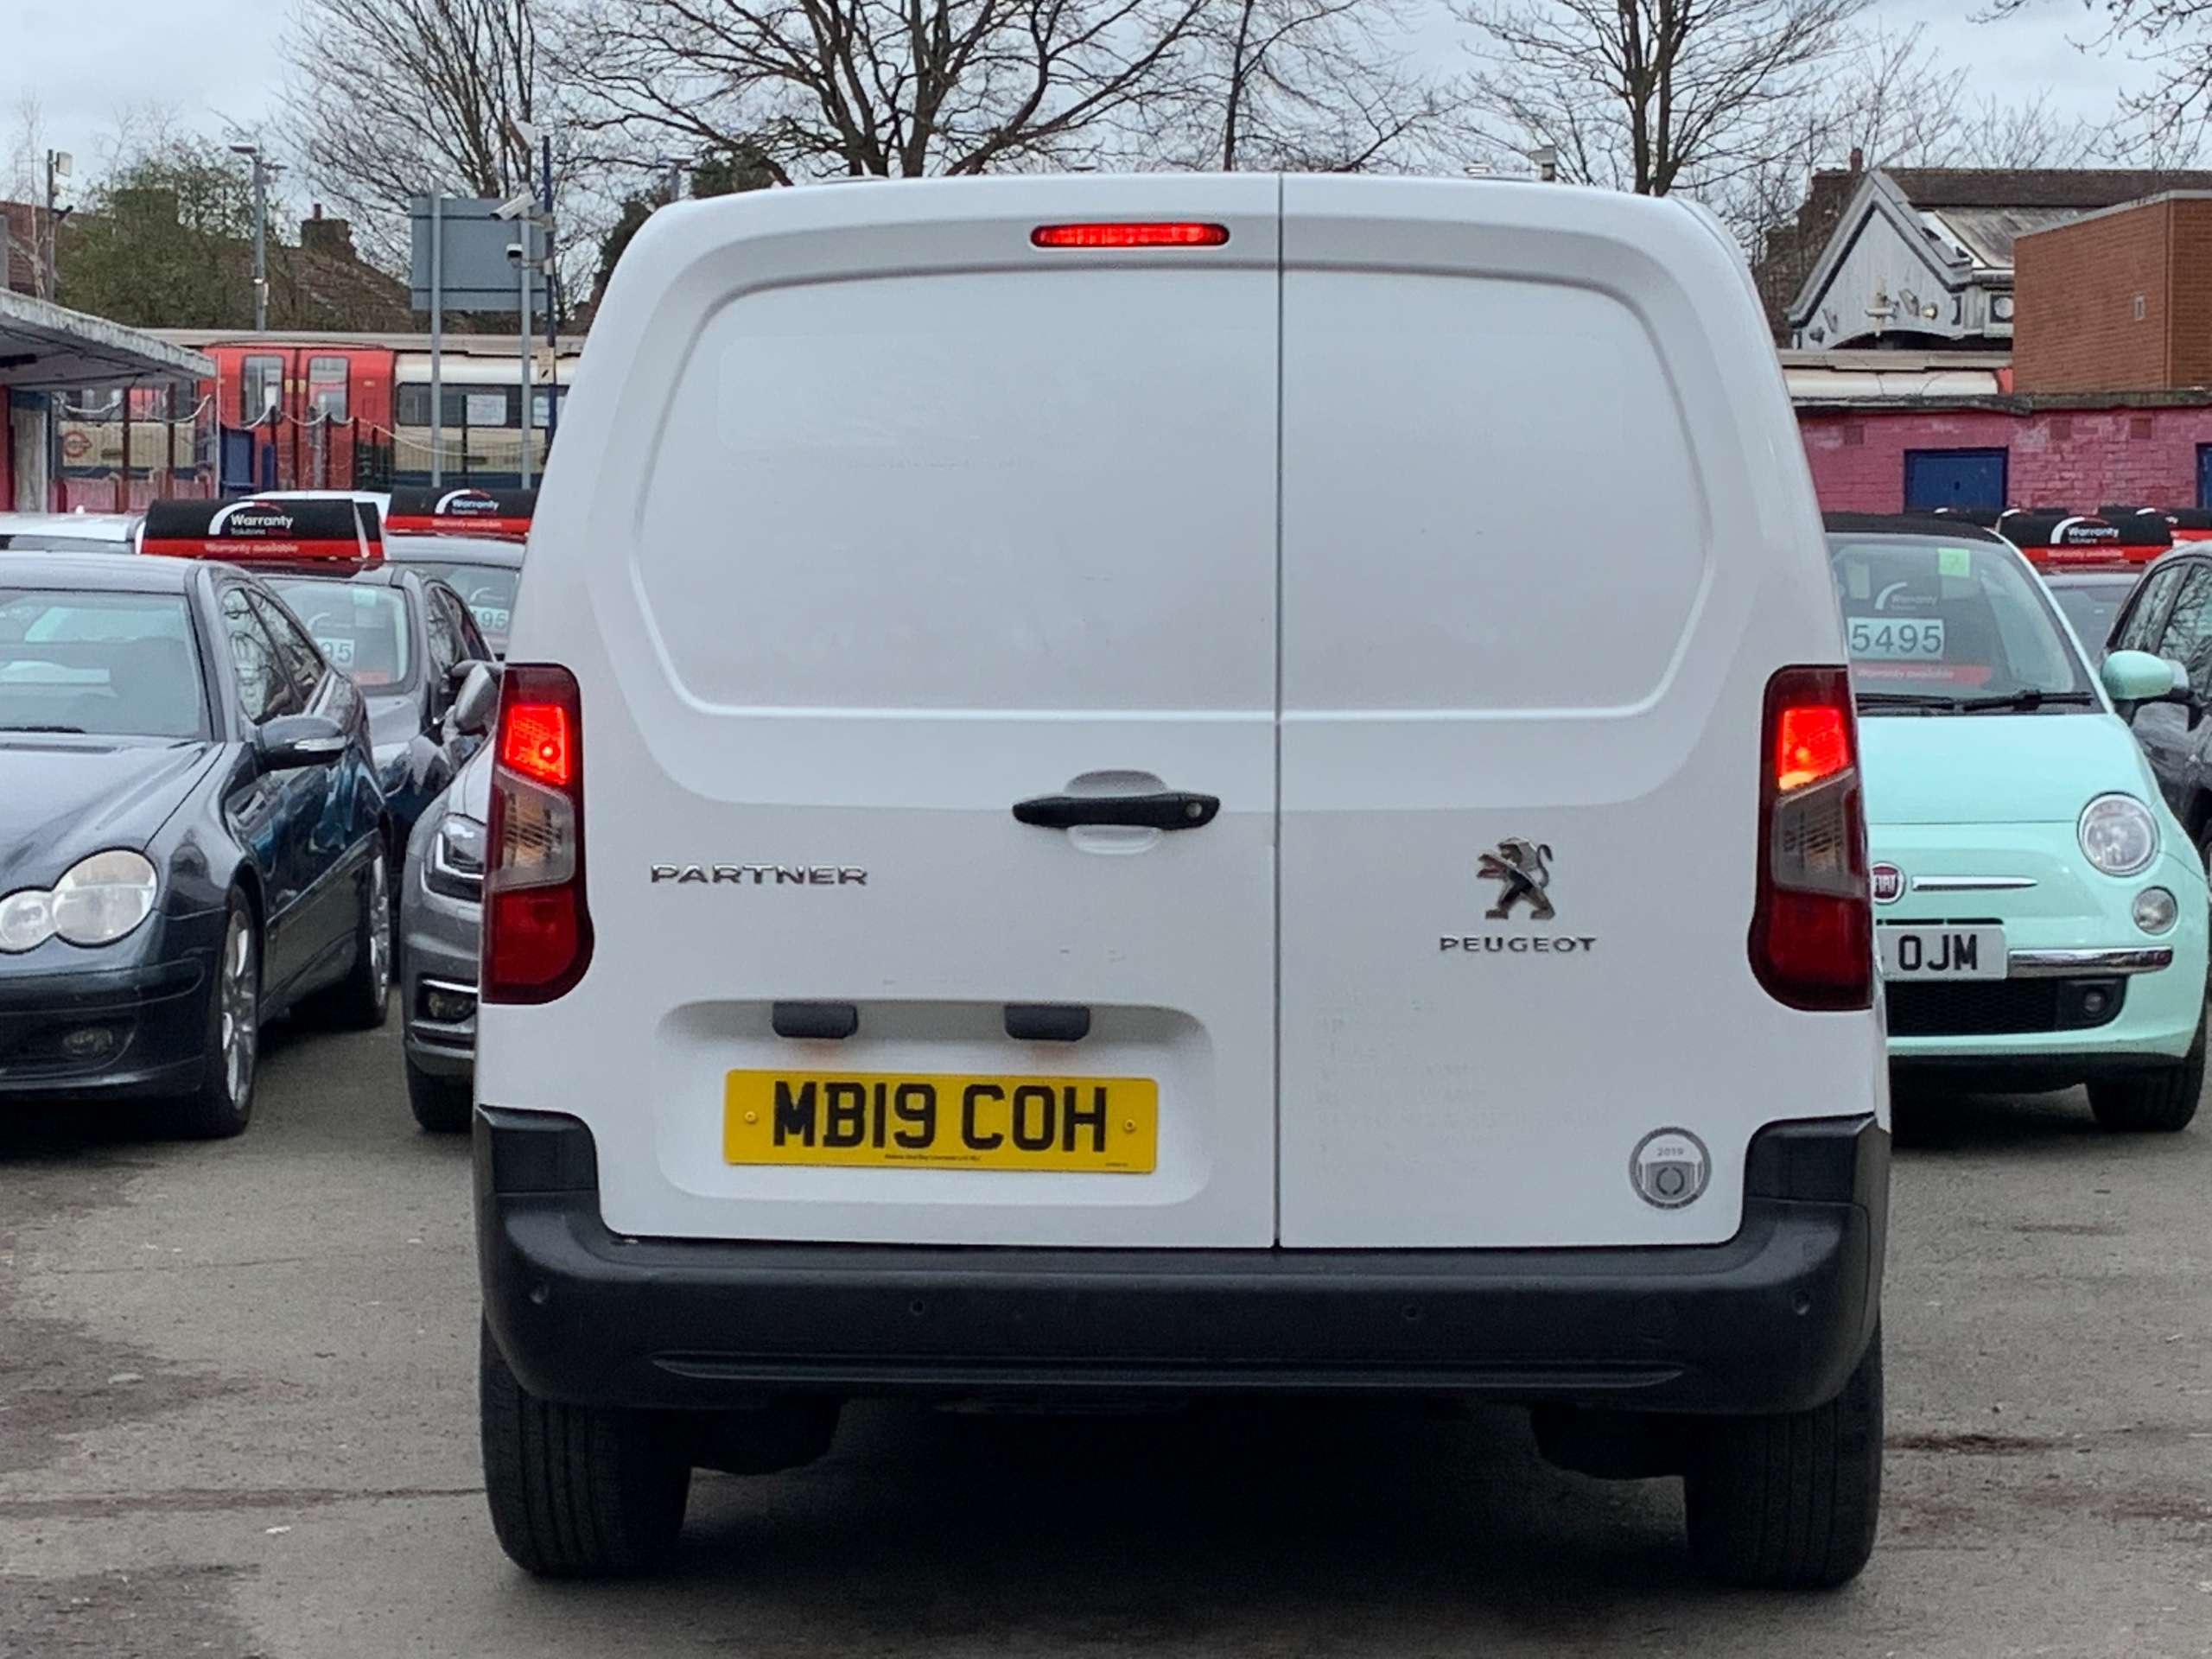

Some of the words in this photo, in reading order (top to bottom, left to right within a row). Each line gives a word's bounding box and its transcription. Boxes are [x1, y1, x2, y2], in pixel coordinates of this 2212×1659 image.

[230, 513, 294, 529] Warranty
[474, 610, 507, 630] 95
[1852, 624, 1942, 653] 5495
[651, 864, 868, 885] PARTNER
[1440, 936, 1597, 953] PEUGEOT
[1898, 934, 1978, 971] OJM
[773, 1080, 937, 1149] MB19
[962, 1084, 1107, 1153] COH
